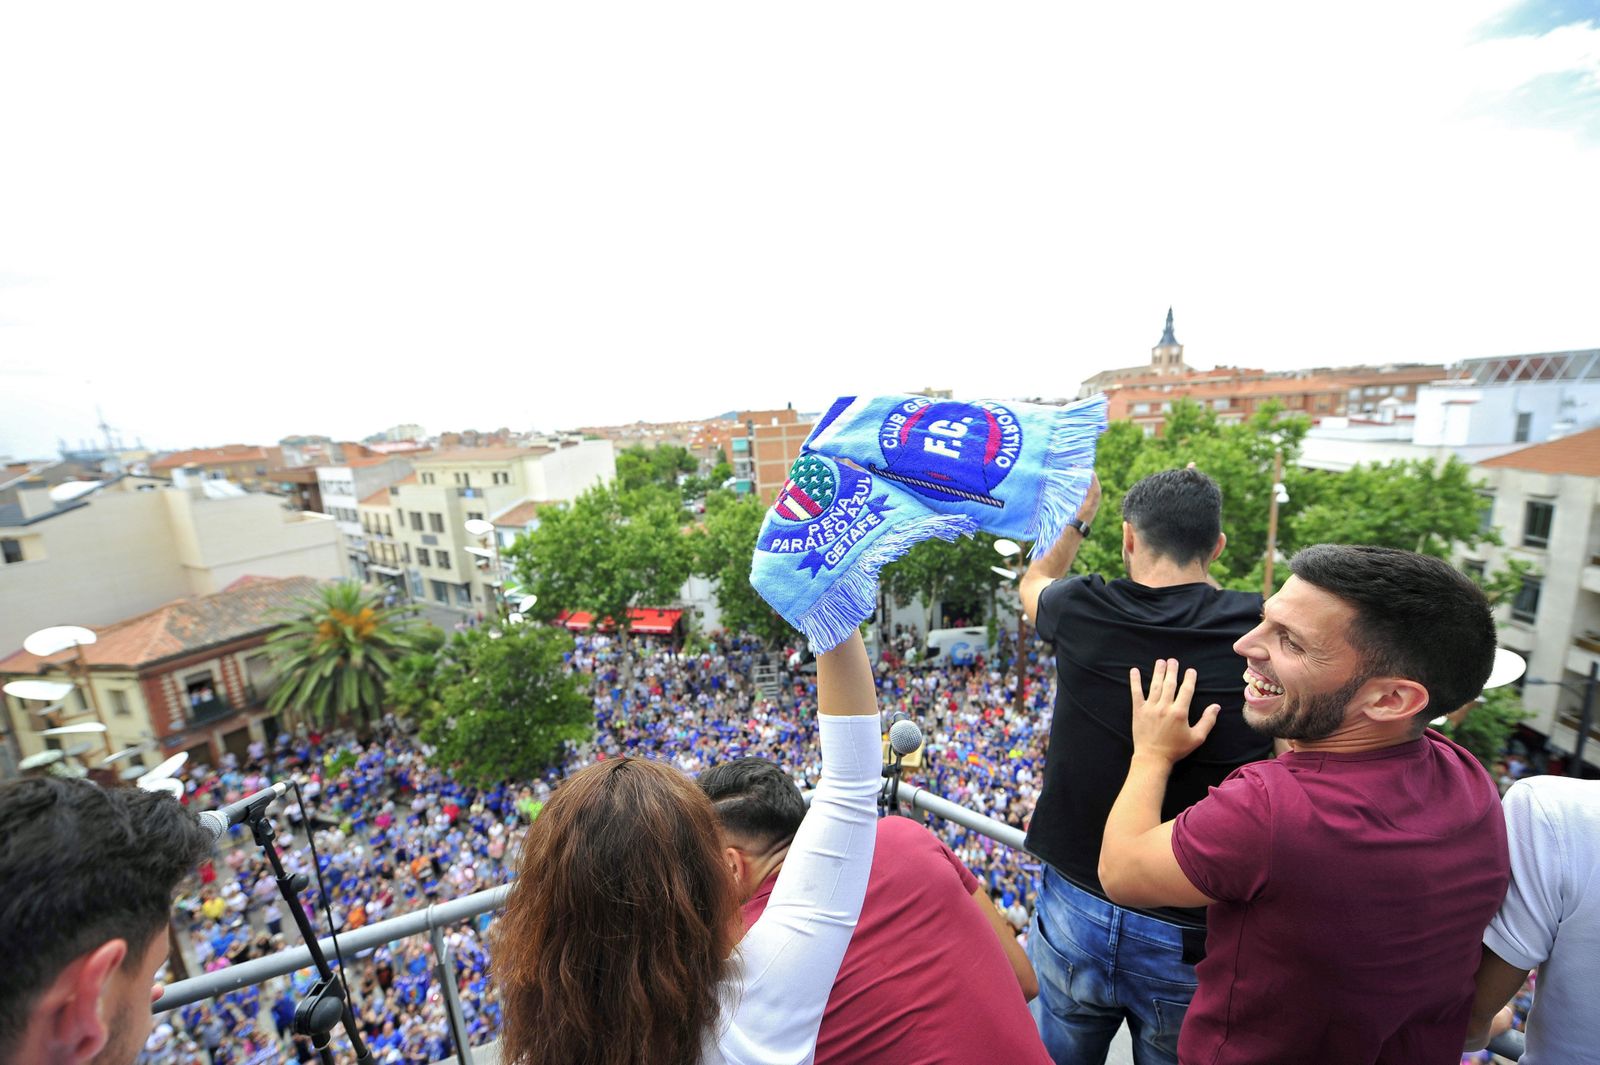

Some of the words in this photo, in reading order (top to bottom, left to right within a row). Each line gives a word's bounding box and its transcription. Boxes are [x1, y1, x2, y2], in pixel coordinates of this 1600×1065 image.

[882, 413, 907, 448] CLUB
[923, 416, 973, 459] F.C.
[770, 519, 848, 553] PARAISO
[846, 477, 871, 519] AZUL
[808, 498, 851, 537] PEÑA
[825, 512, 880, 566] GETAFE
